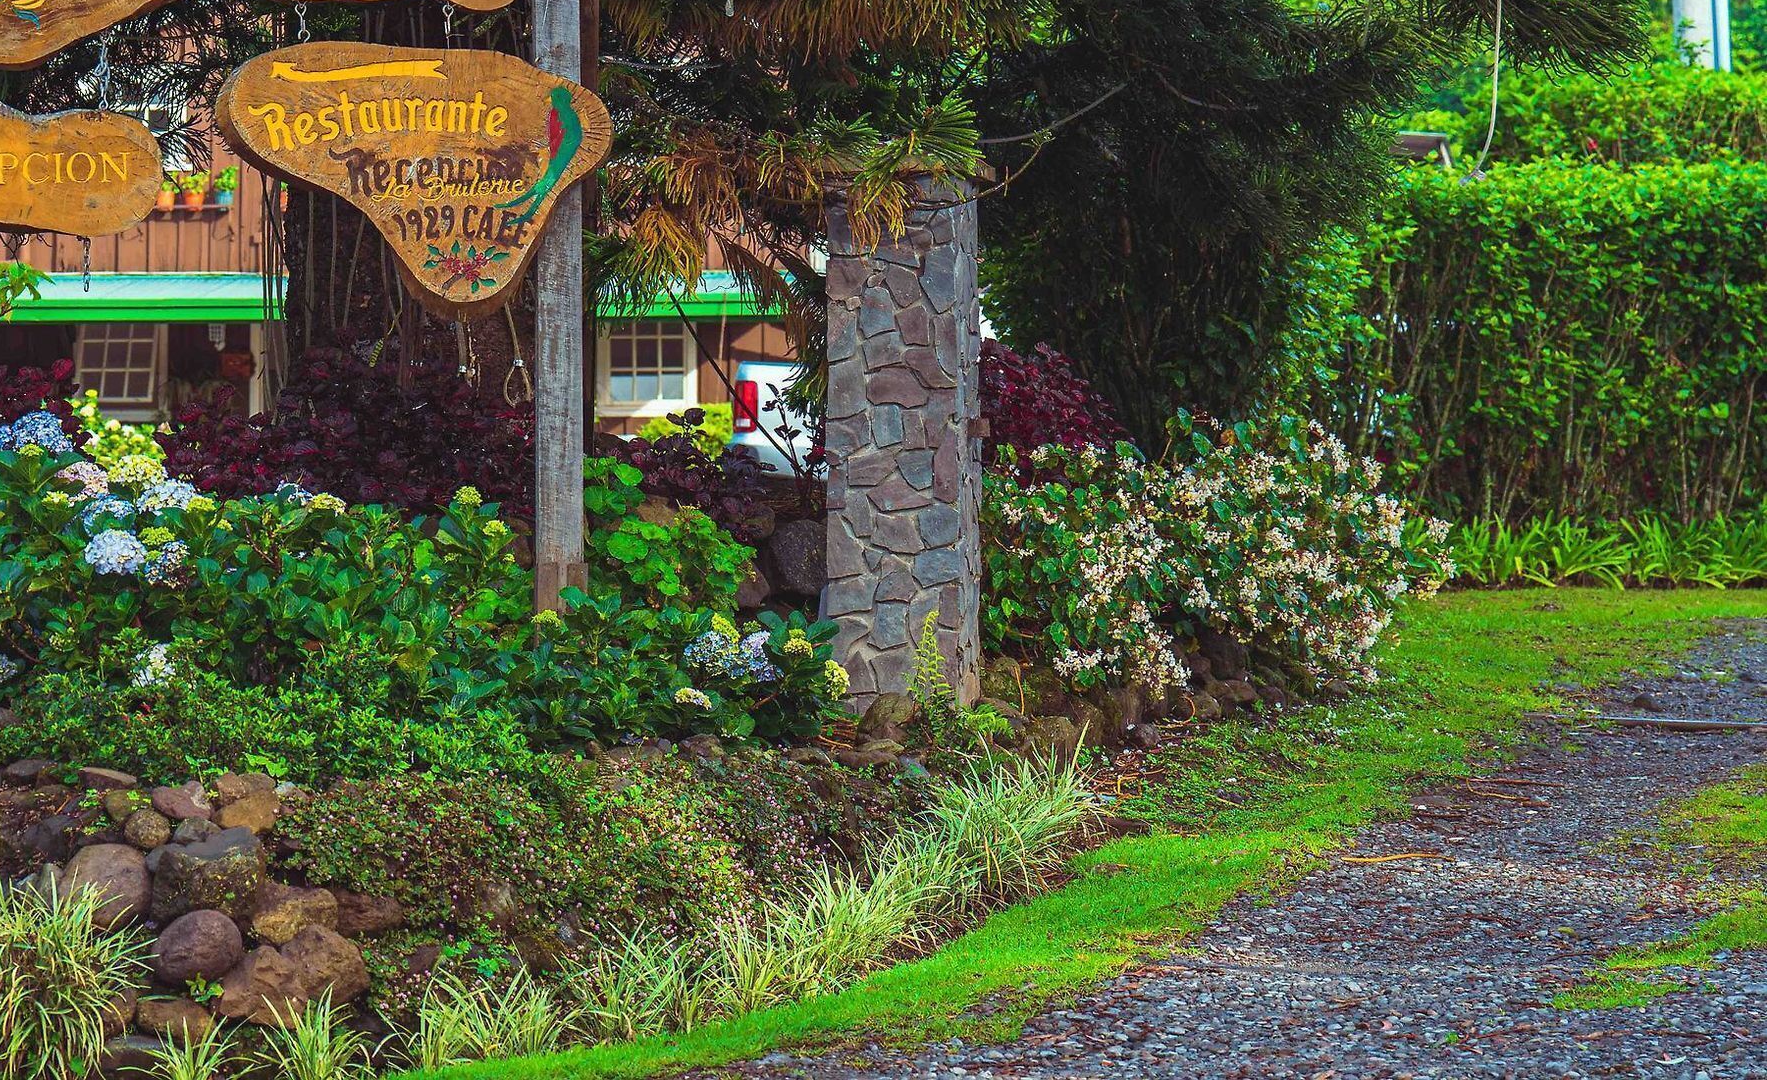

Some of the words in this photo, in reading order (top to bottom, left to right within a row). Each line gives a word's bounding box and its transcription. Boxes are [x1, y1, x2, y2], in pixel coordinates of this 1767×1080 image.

[247, 90, 509, 152] Restaurante
[371, 176, 412, 202] La
[391, 205, 455, 241] 1929
